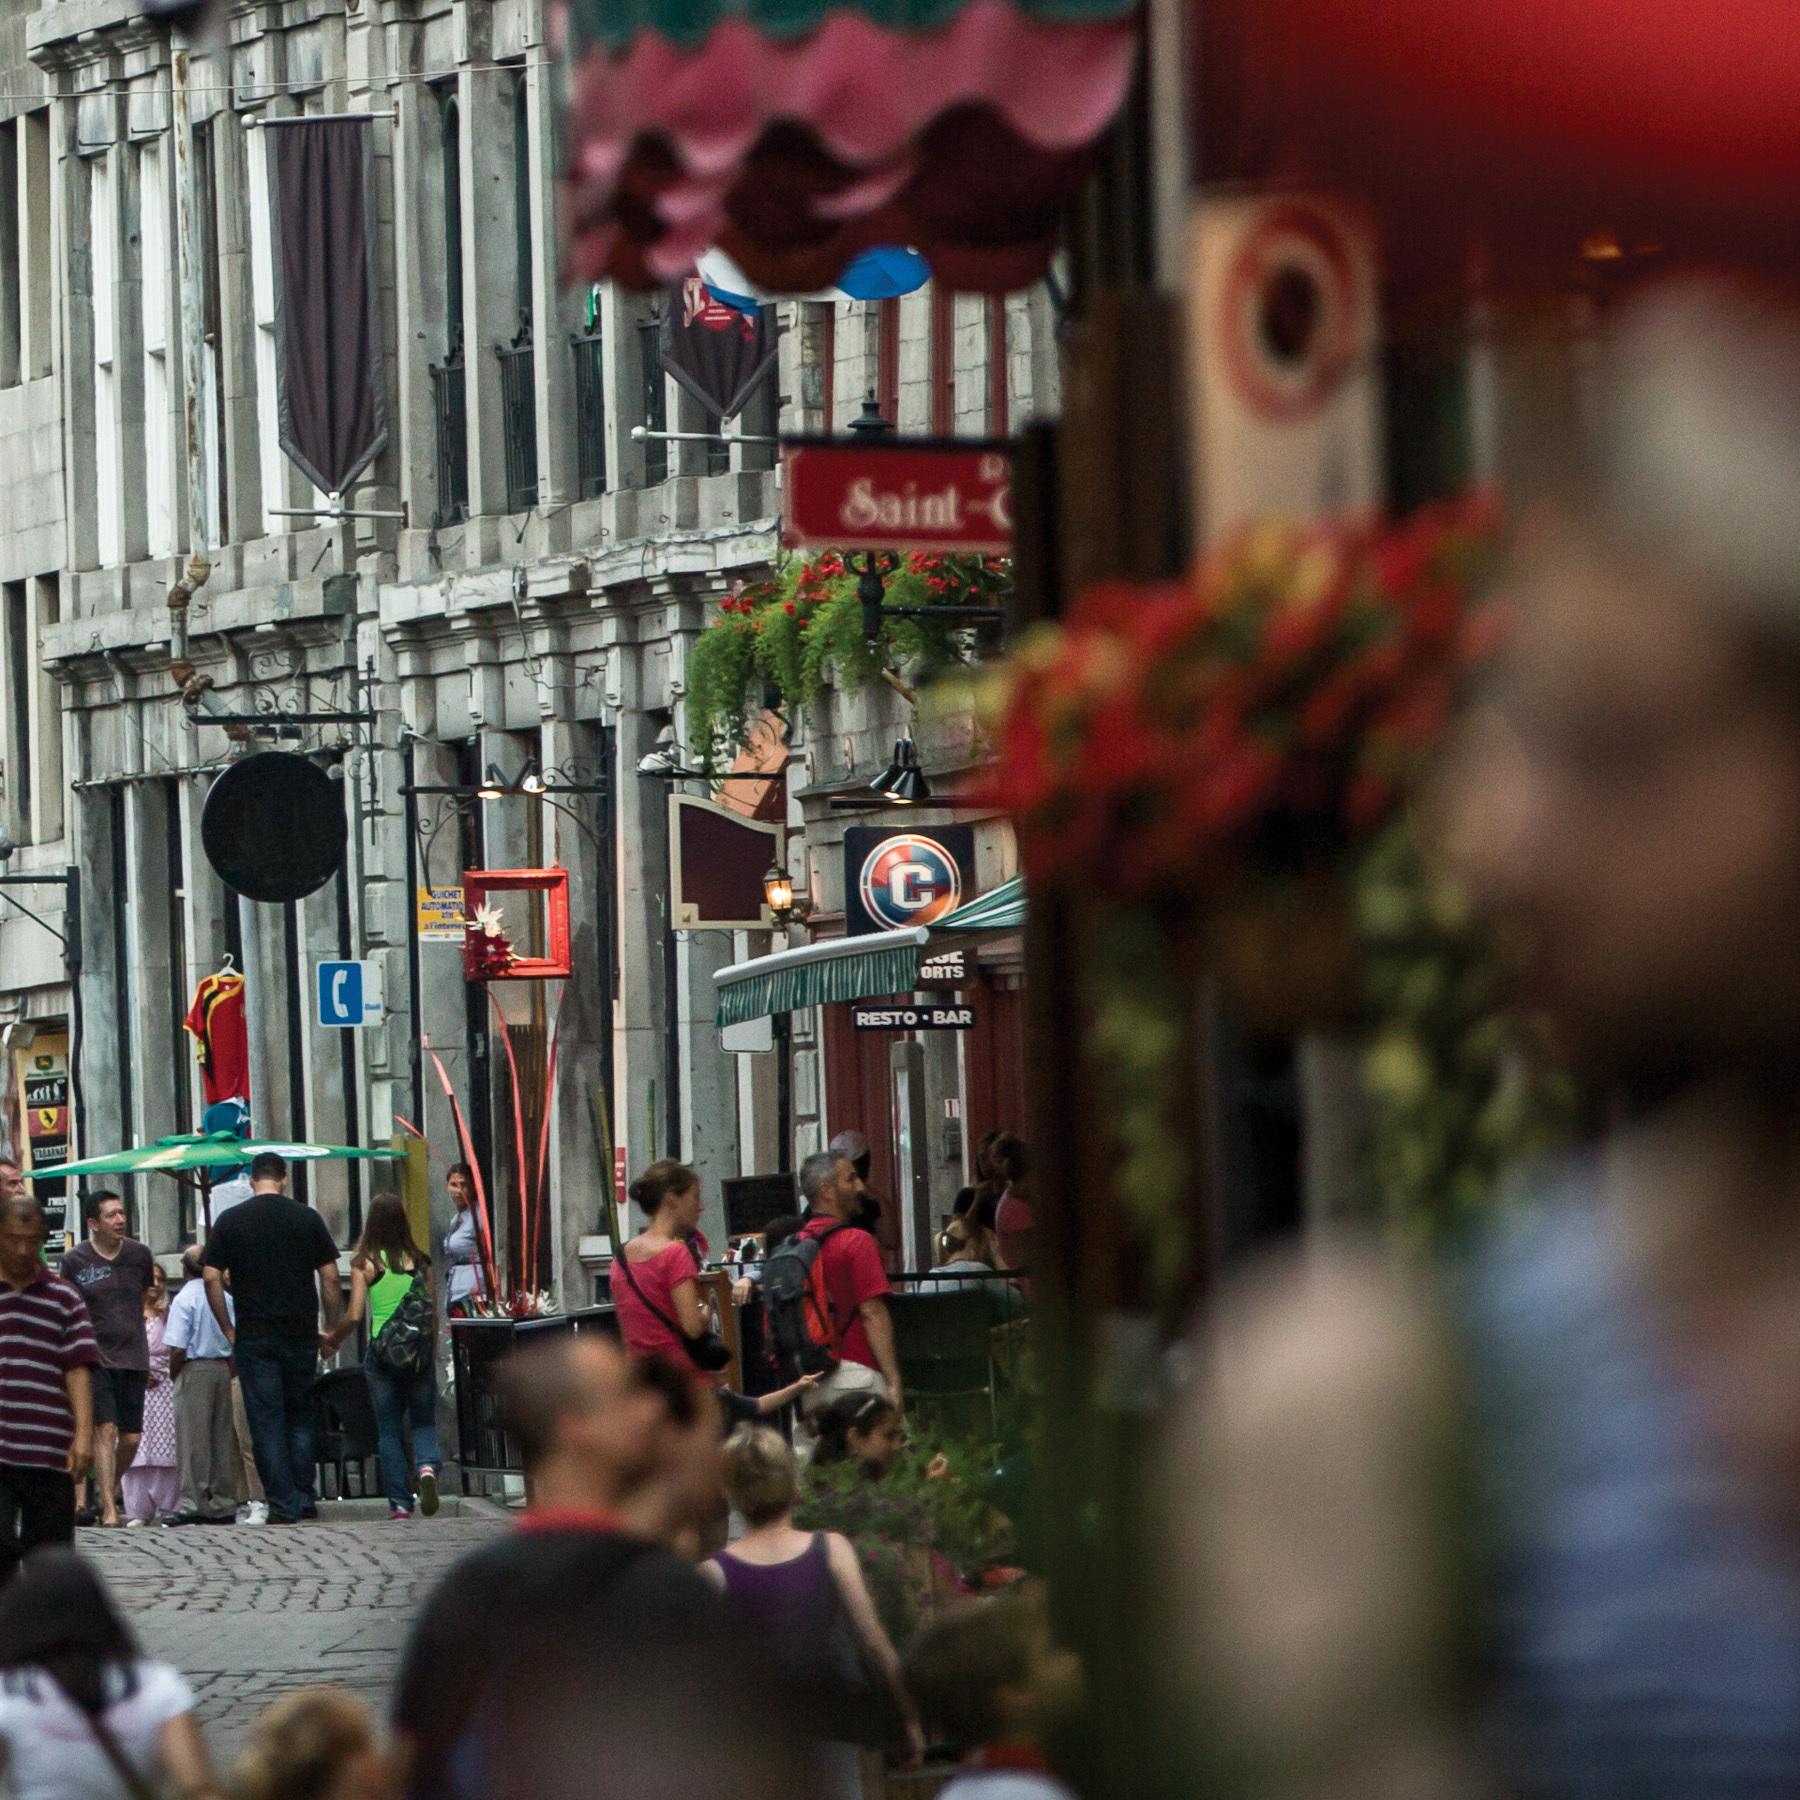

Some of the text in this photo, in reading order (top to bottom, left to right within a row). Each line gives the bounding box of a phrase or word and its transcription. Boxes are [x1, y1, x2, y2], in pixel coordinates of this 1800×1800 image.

[421, 901, 465, 911] AUTOMATIQ
[920, 965, 965, 979] ORTS
[857, 1009, 973, 1026] RESTO BAR
